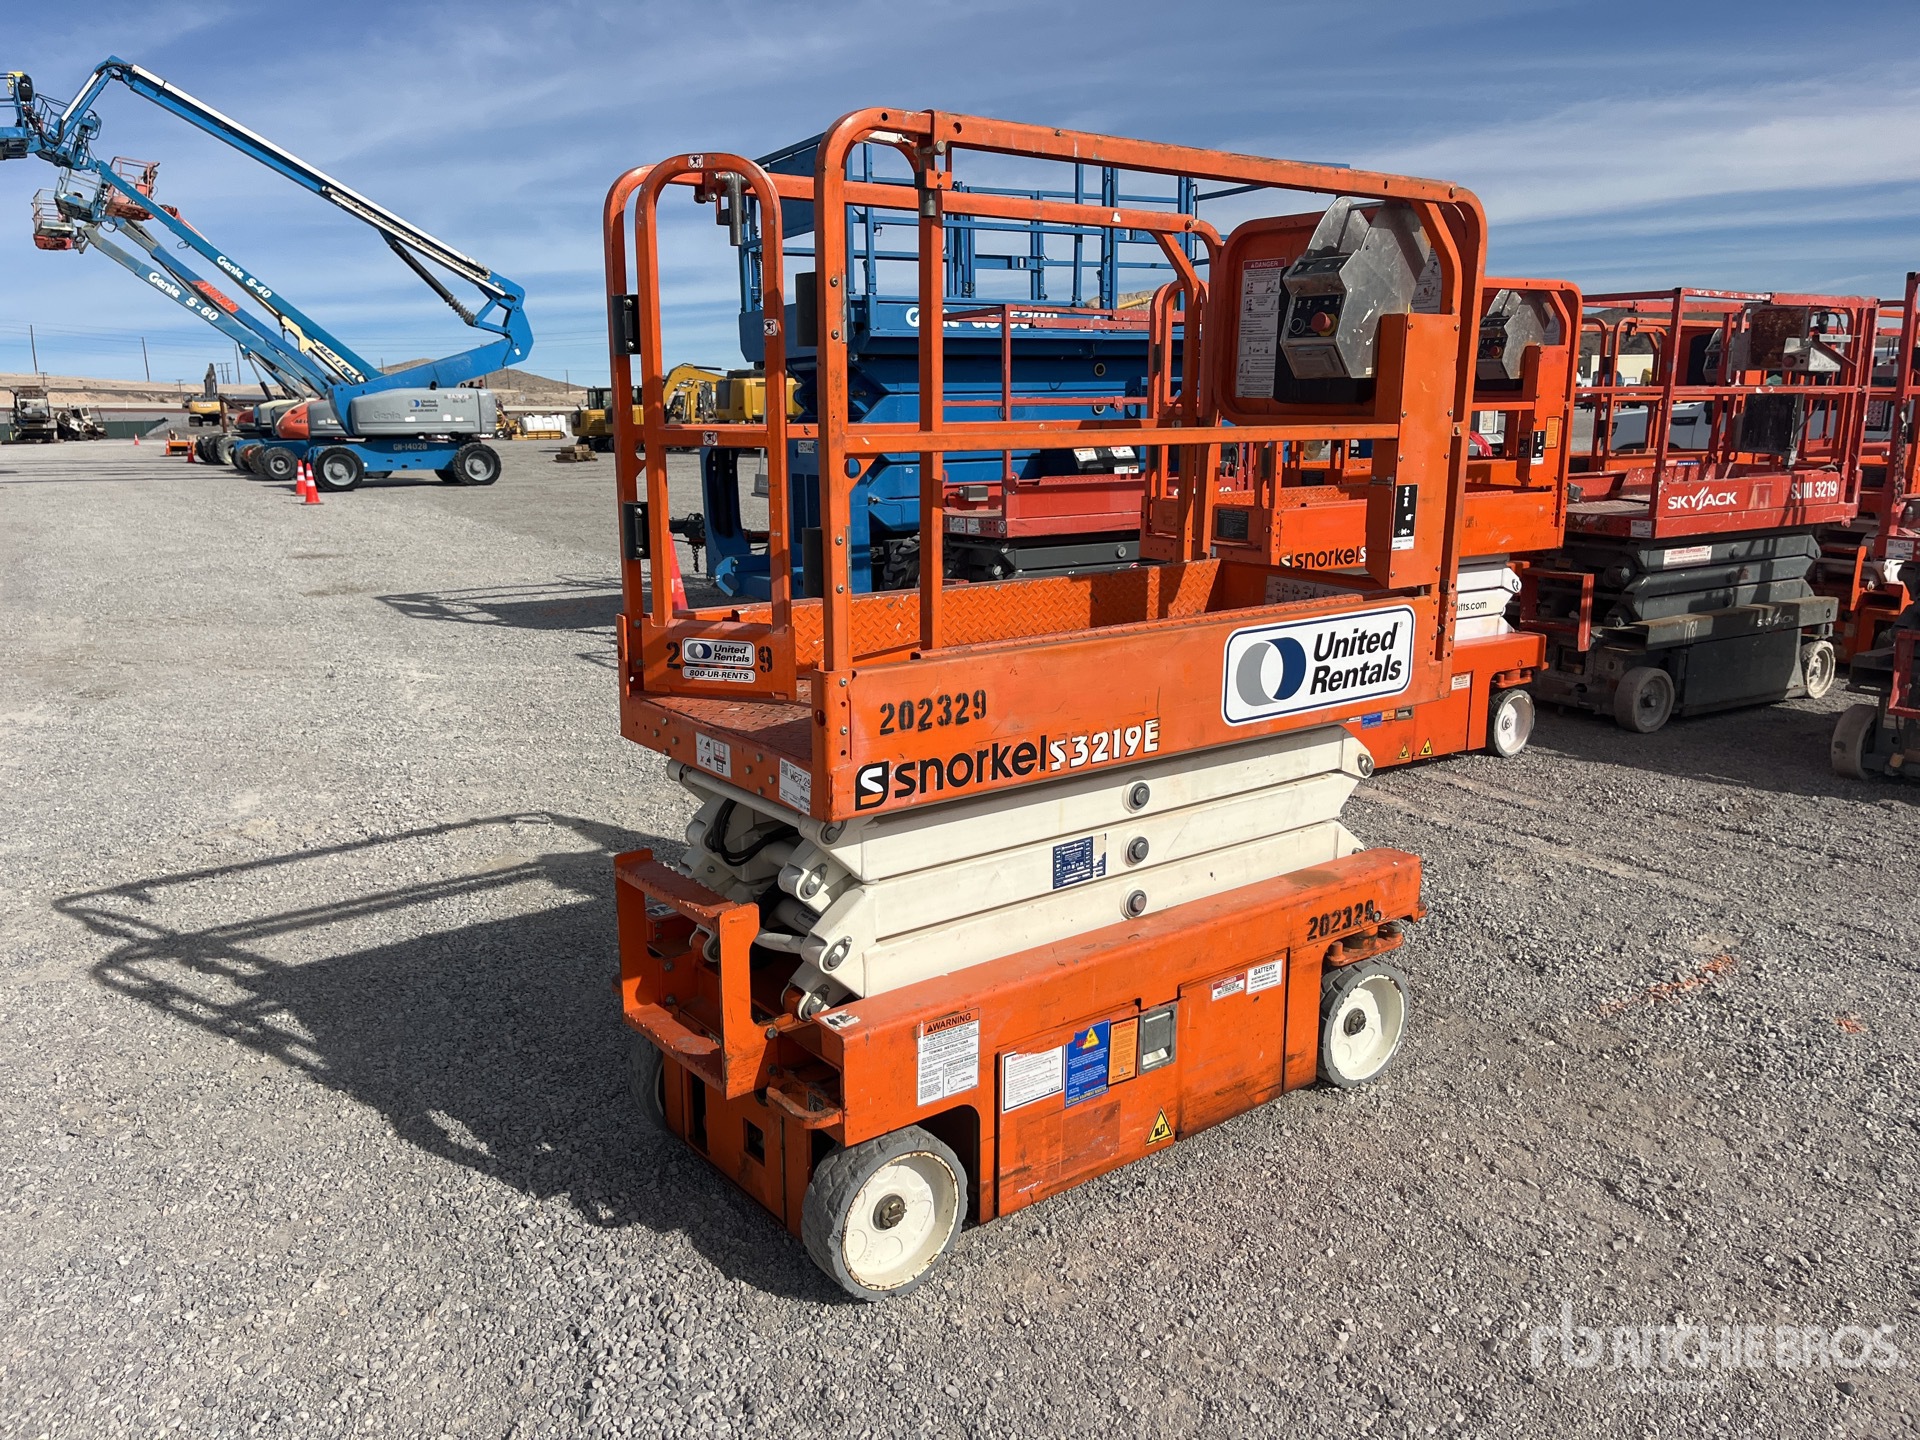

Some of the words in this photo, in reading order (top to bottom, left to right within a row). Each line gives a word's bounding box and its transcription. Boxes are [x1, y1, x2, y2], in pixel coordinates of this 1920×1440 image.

[217, 255, 244, 280] Genie
[246, 277, 272, 299] S-40
[1254, 261, 1279, 269] DANGER
[148, 272, 180, 299] Genie
[186, 296, 219, 321] S-60
[1667, 486, 1737, 511] SKYJACK
[1815, 480, 1838, 498] 3219
[714, 644, 748, 654] United
[1314, 621, 1399, 662] United
[714, 653, 750, 663] Rentals
[689, 669, 749, 680] 800-UR-RENTS
[1309, 654, 1403, 696] Rentals
[879, 689, 987, 736] 202329
[894, 735, 1047, 799] snorkel
[1307, 899, 1374, 941] 202329
[1253, 964, 1276, 976] BATTERY
[933, 1012, 972, 1031] WARNING
